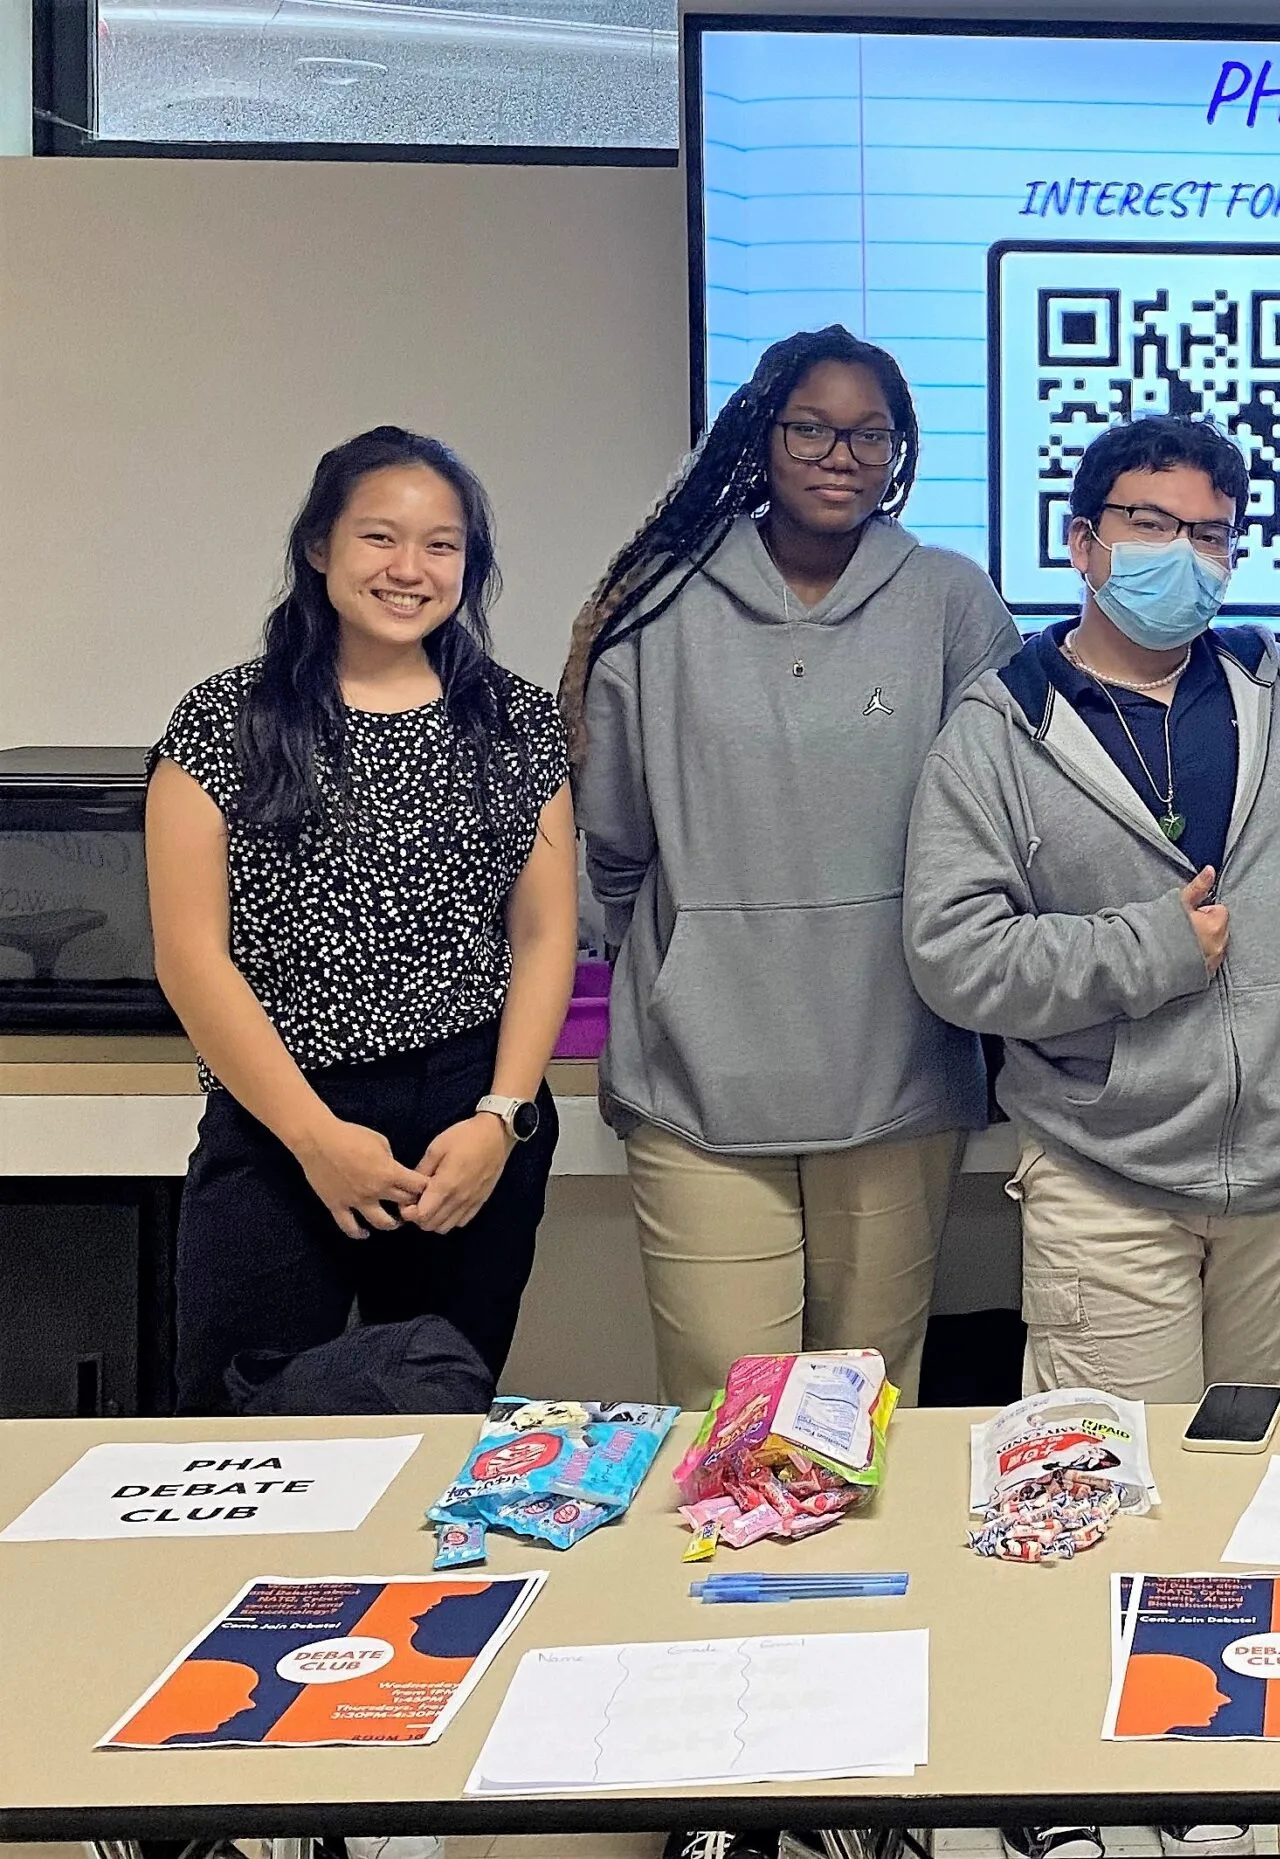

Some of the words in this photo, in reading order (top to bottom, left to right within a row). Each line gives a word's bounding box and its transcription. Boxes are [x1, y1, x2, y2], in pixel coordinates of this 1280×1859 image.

[1019, 177, 1222, 218] INTEREST
[1098, 1424, 1130, 1440] PAID
[183, 1457, 283, 1473] PHA
[111, 1480, 315, 1499] DEBATE
[120, 1505, 257, 1522] CLUB
[1170, 1582, 1214, 1590] Debate
[276, 1588, 321, 1596] Debate
[1139, 1615, 1177, 1624] Come
[1178, 1615, 1205, 1624] Join
[1207, 1616, 1258, 1624] Debate!
[221, 1622, 259, 1630] Come
[260, 1622, 288, 1631] Join
[289, 1621, 342, 1630] Debate!
[294, 1649, 384, 1661] DEBATE
[538, 1652, 584, 1663] Name
[299, 1661, 361, 1671] CLUB
[391, 1689, 426, 1697] from
